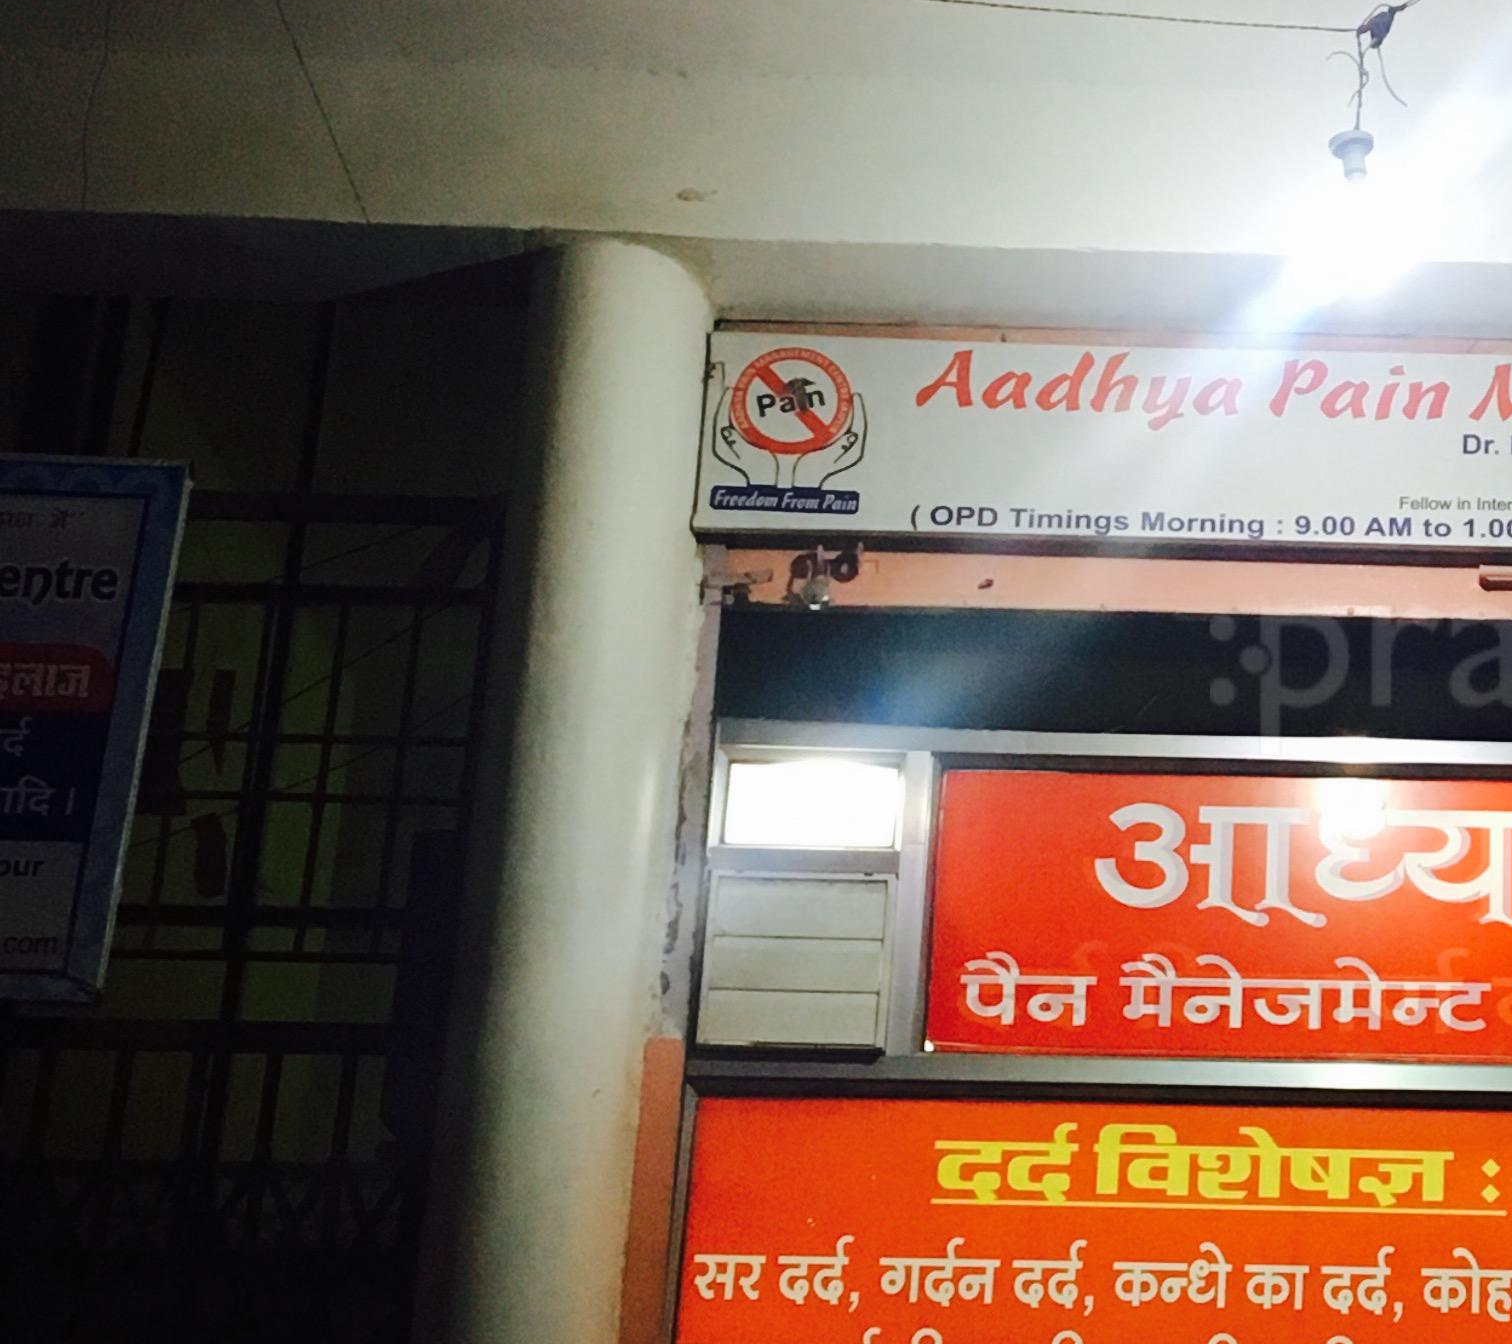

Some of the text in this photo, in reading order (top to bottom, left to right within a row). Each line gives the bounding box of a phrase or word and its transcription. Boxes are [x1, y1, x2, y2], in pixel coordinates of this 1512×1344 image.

[915, 349, 1243, 432] Aadhya
[1269, 359, 1451, 421] Pain
[1462, 434, 1500, 456] Dr.
[714, 489, 857, 511] Freedom From Pain
[930, 505, 999, 528] OPD
[1010, 508, 1130, 536] Timings
[1140, 511, 1265, 540] Morning
[1295, 515, 1356, 537] 9.00
[1364, 516, 1413, 537] AM
[1424, 519, 1451, 537] to
[1399, 496, 1452, 511] Fellow
[1457, 498, 1471, 511] in
[959, 950, 1097, 1026] पैन
[1120, 953, 1492, 1033] मैनेजमेन्ट
[935, 1122, 1454, 1207] दर्द विशेषज्ञ
[693, 1254, 766, 1300] सर
[778, 1235, 860, 1313] दर्द,
[880, 1237, 1000, 1306] गर्दन
[1012, 1240, 1095, 1316] दर्द,
[1113, 1242, 1232, 1309] कन्धे
[1245, 1264, 1308, 1311] का
